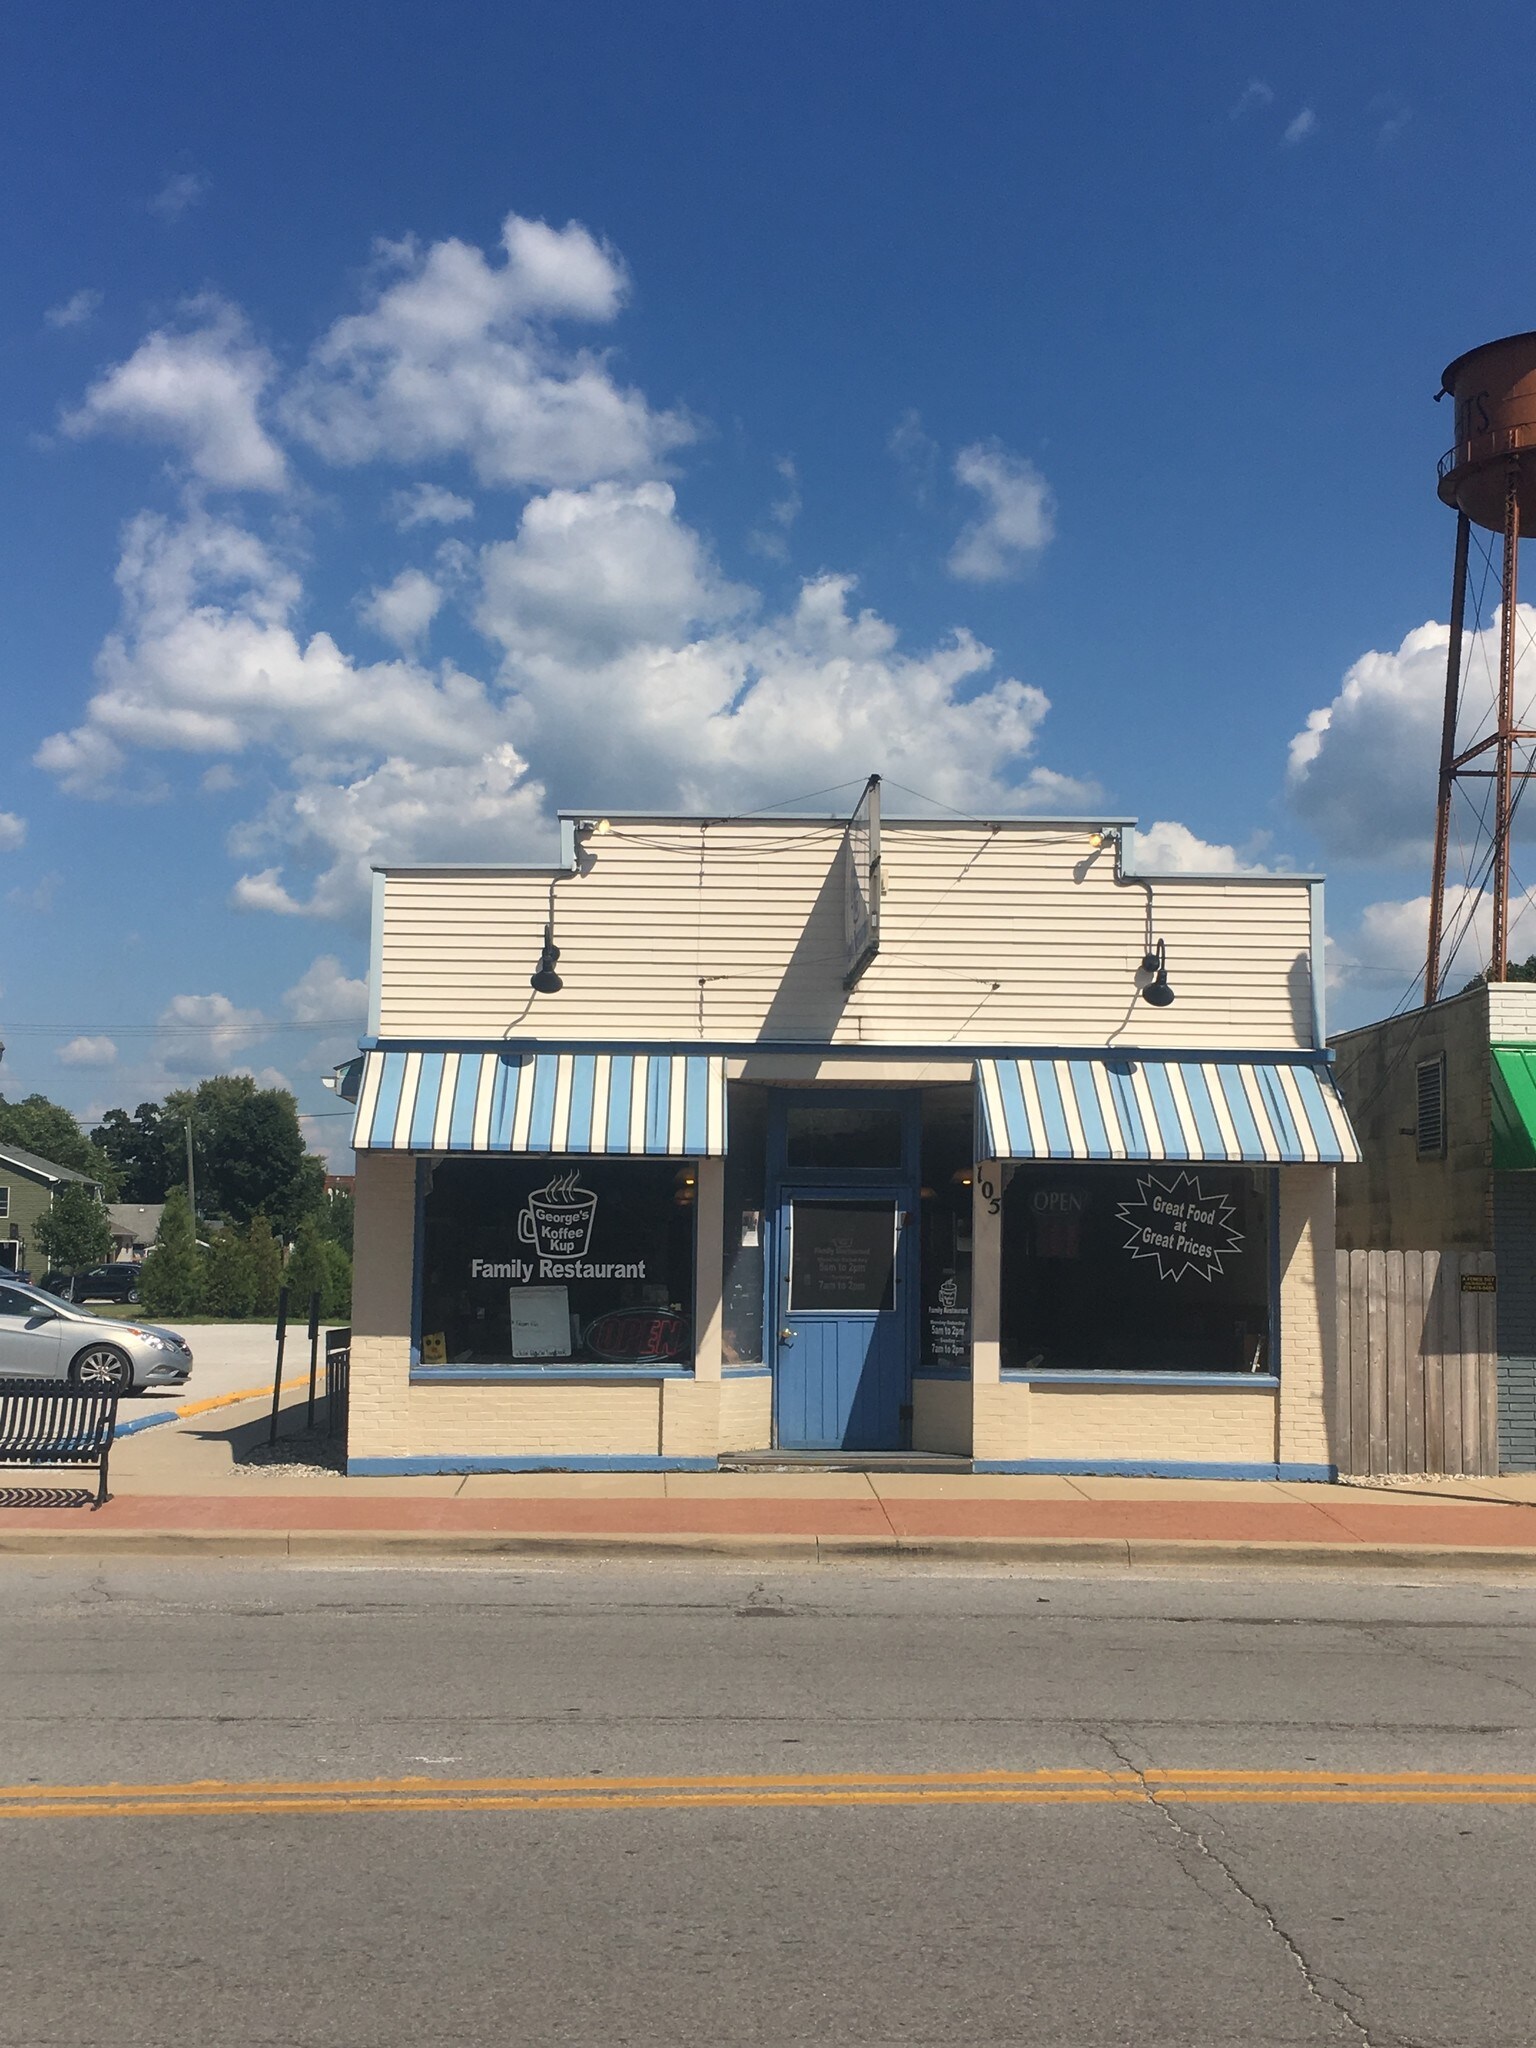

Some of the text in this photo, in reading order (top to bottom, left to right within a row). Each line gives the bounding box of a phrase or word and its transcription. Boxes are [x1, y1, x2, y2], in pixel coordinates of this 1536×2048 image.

[1033, 1191, 1082, 1211] OPEN
[535, 1208, 589, 1225] George's
[1153, 1195, 1216, 1225] Great Food
[541, 1225, 584, 1240] Koffee
[1174, 1220, 1188, 1233] at
[550, 1239, 575, 1254] Kup
[1142, 1227, 1212, 1258] Great Prices
[472, 1258, 645, 1282] Family Restaurant
[931, 1325, 965, 1338] 5am to 2pm
[931, 1343, 965, 1356] 7am to 2pm
